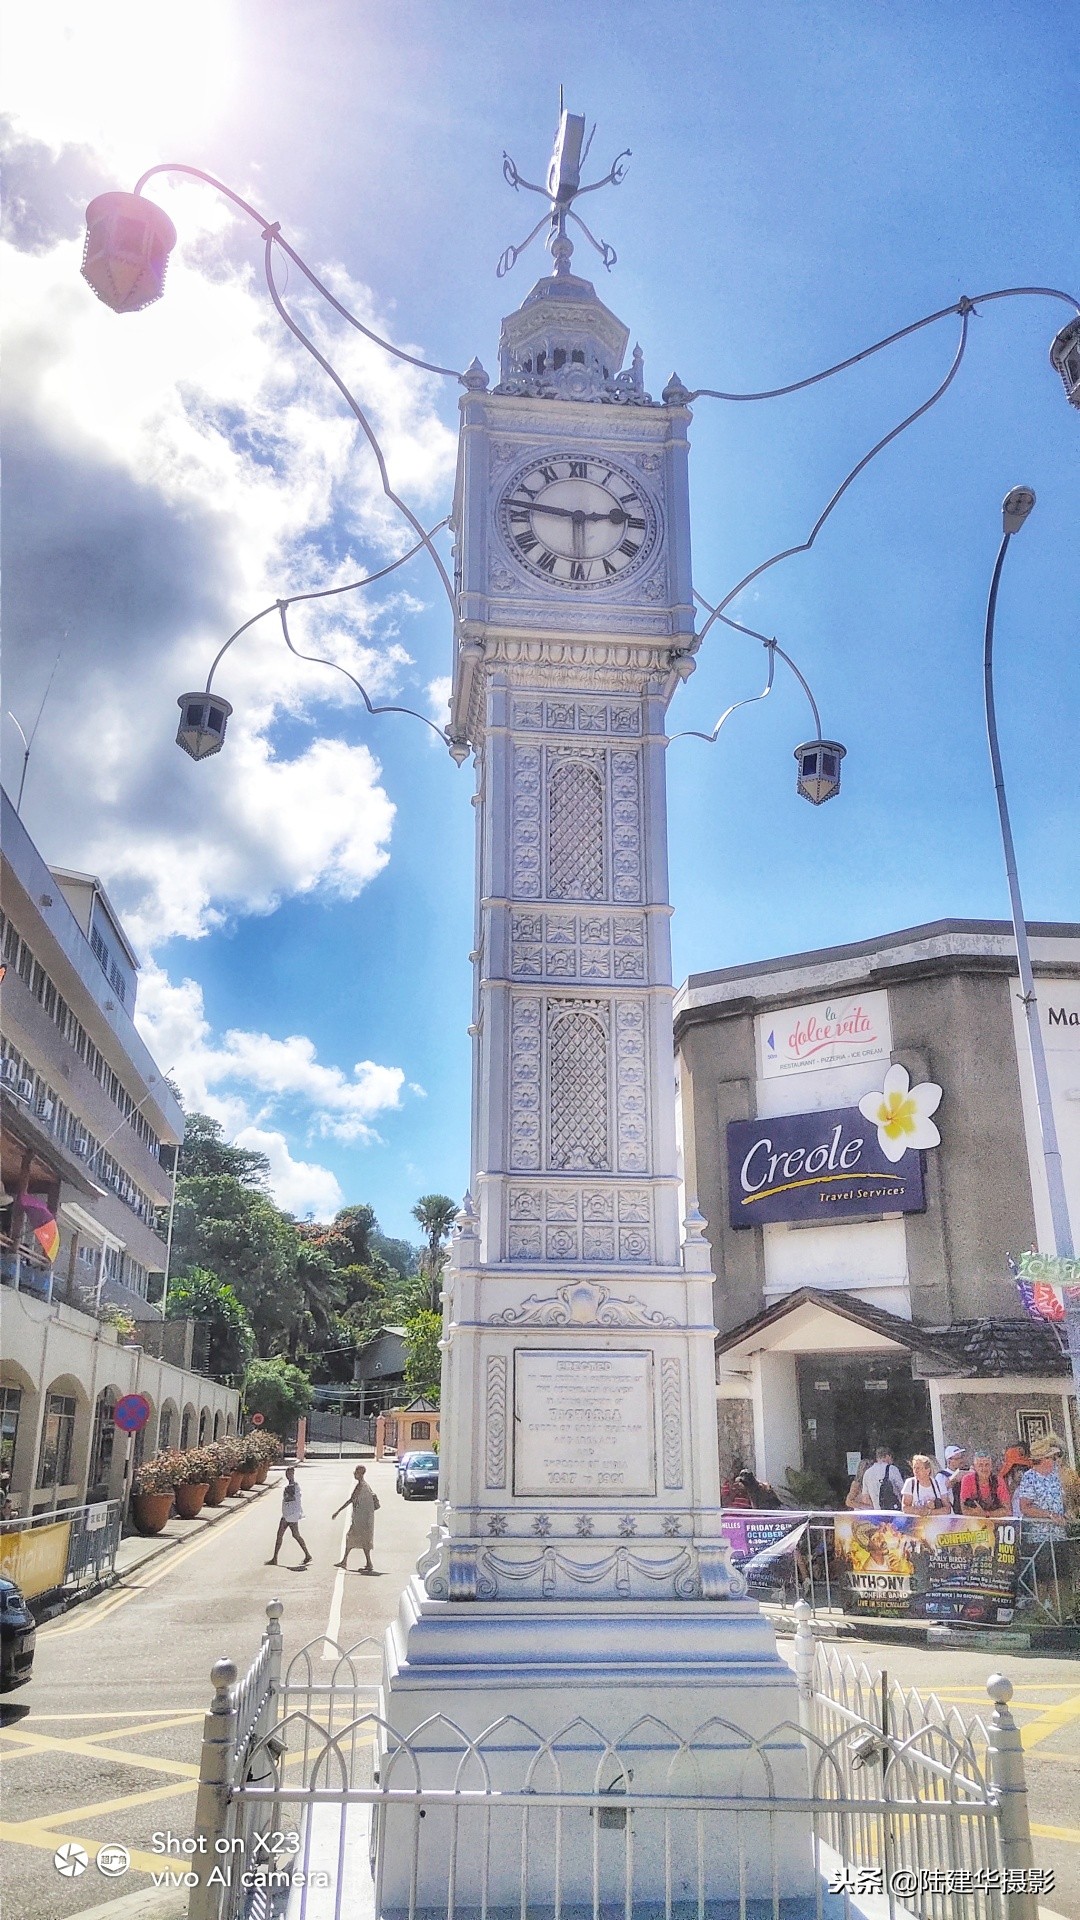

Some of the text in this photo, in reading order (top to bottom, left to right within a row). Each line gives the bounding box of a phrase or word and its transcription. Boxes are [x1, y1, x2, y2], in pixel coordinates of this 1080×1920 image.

[540, 466, 558, 484] XI
[569, 461, 588, 478] XII
[602, 471, 613, 485] I
[517, 484, 538, 500] X
[620, 493, 638, 504] II
[510, 510, 530, 522] IX
[628, 517, 646, 529] III
[515, 530, 539, 554] VIII
[536, 551, 557, 573] VII
[603, 558, 617, 576] V
[826, 1006, 836, 1021] la
[788, 1007, 872, 1055] dolce vita
[779, 1058, 815, 1070] RESTAURANT
[820, 1054, 846, 1064] PIZZERIA
[850, 1051, 861, 1059] ICE
[861, 1047, 883, 1057] CREAM
[740, 1124, 864, 1193] Creole
[820, 1187, 905, 1202] Travel Services
[746, 1524, 773, 1532] FRIDAY
[997, 1526, 1015, 1545] 10
[998, 1544, 1014, 1554] NOV
[844, 1573, 904, 1590] ANTHONY
[888, 1591, 908, 1599] BAND
